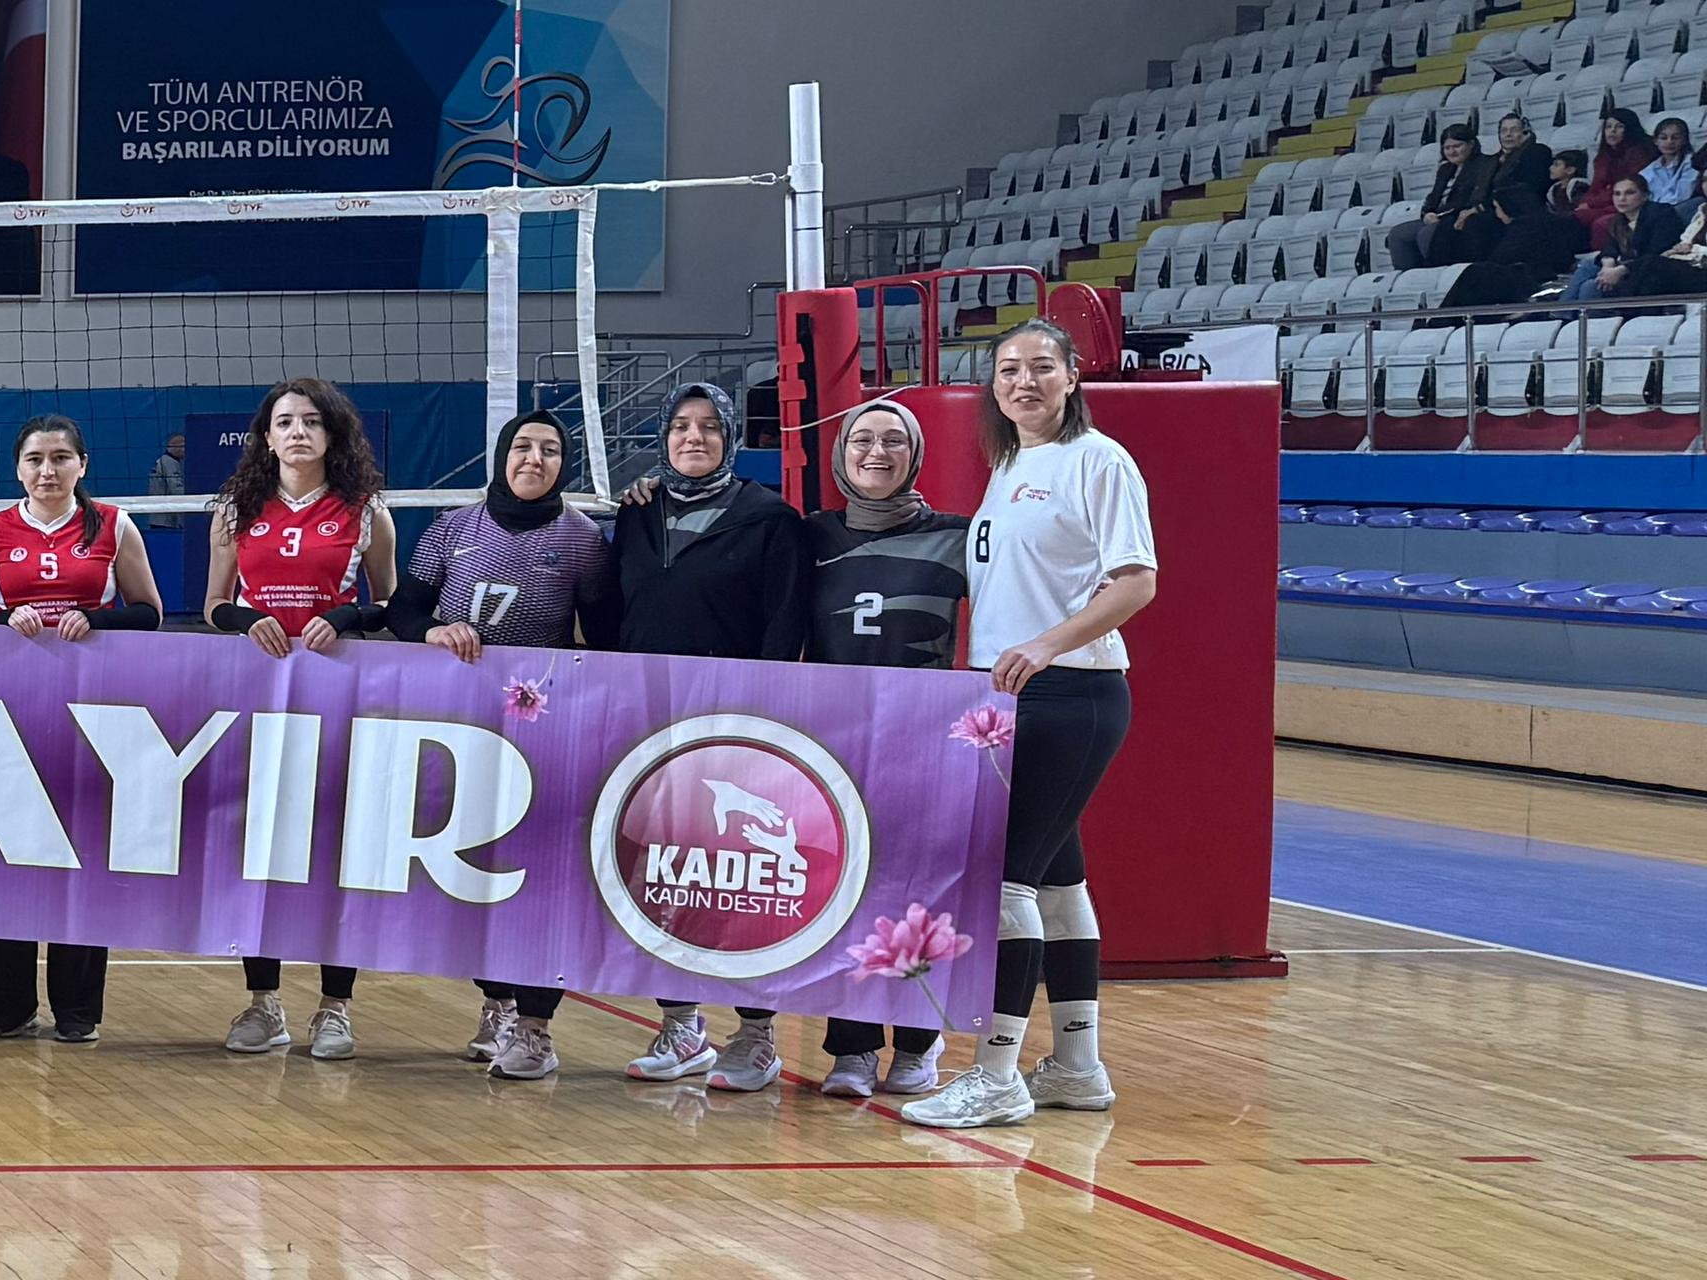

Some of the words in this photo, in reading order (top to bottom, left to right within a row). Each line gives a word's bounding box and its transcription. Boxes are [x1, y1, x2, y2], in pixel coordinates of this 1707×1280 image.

[148, 78, 209, 105] TÜM
[217, 76, 363, 103] ANTRENÖR
[117, 111, 149, 133] VE
[157, 107, 394, 132] SPORCULARIMIZA
[122, 140, 252, 163] BAŞARILAR
[257, 135, 389, 157] DİLİYORUM
[279, 527, 303, 557] 3
[975, 520, 991, 563] 8
[40, 552, 58, 580] 5
[469, 581, 520, 626] 17
[853, 592, 884, 636] 2
[645, 844, 808, 896] KADES
[644, 886, 712, 909] KADIN
[718, 893, 804, 918] DESTEK
